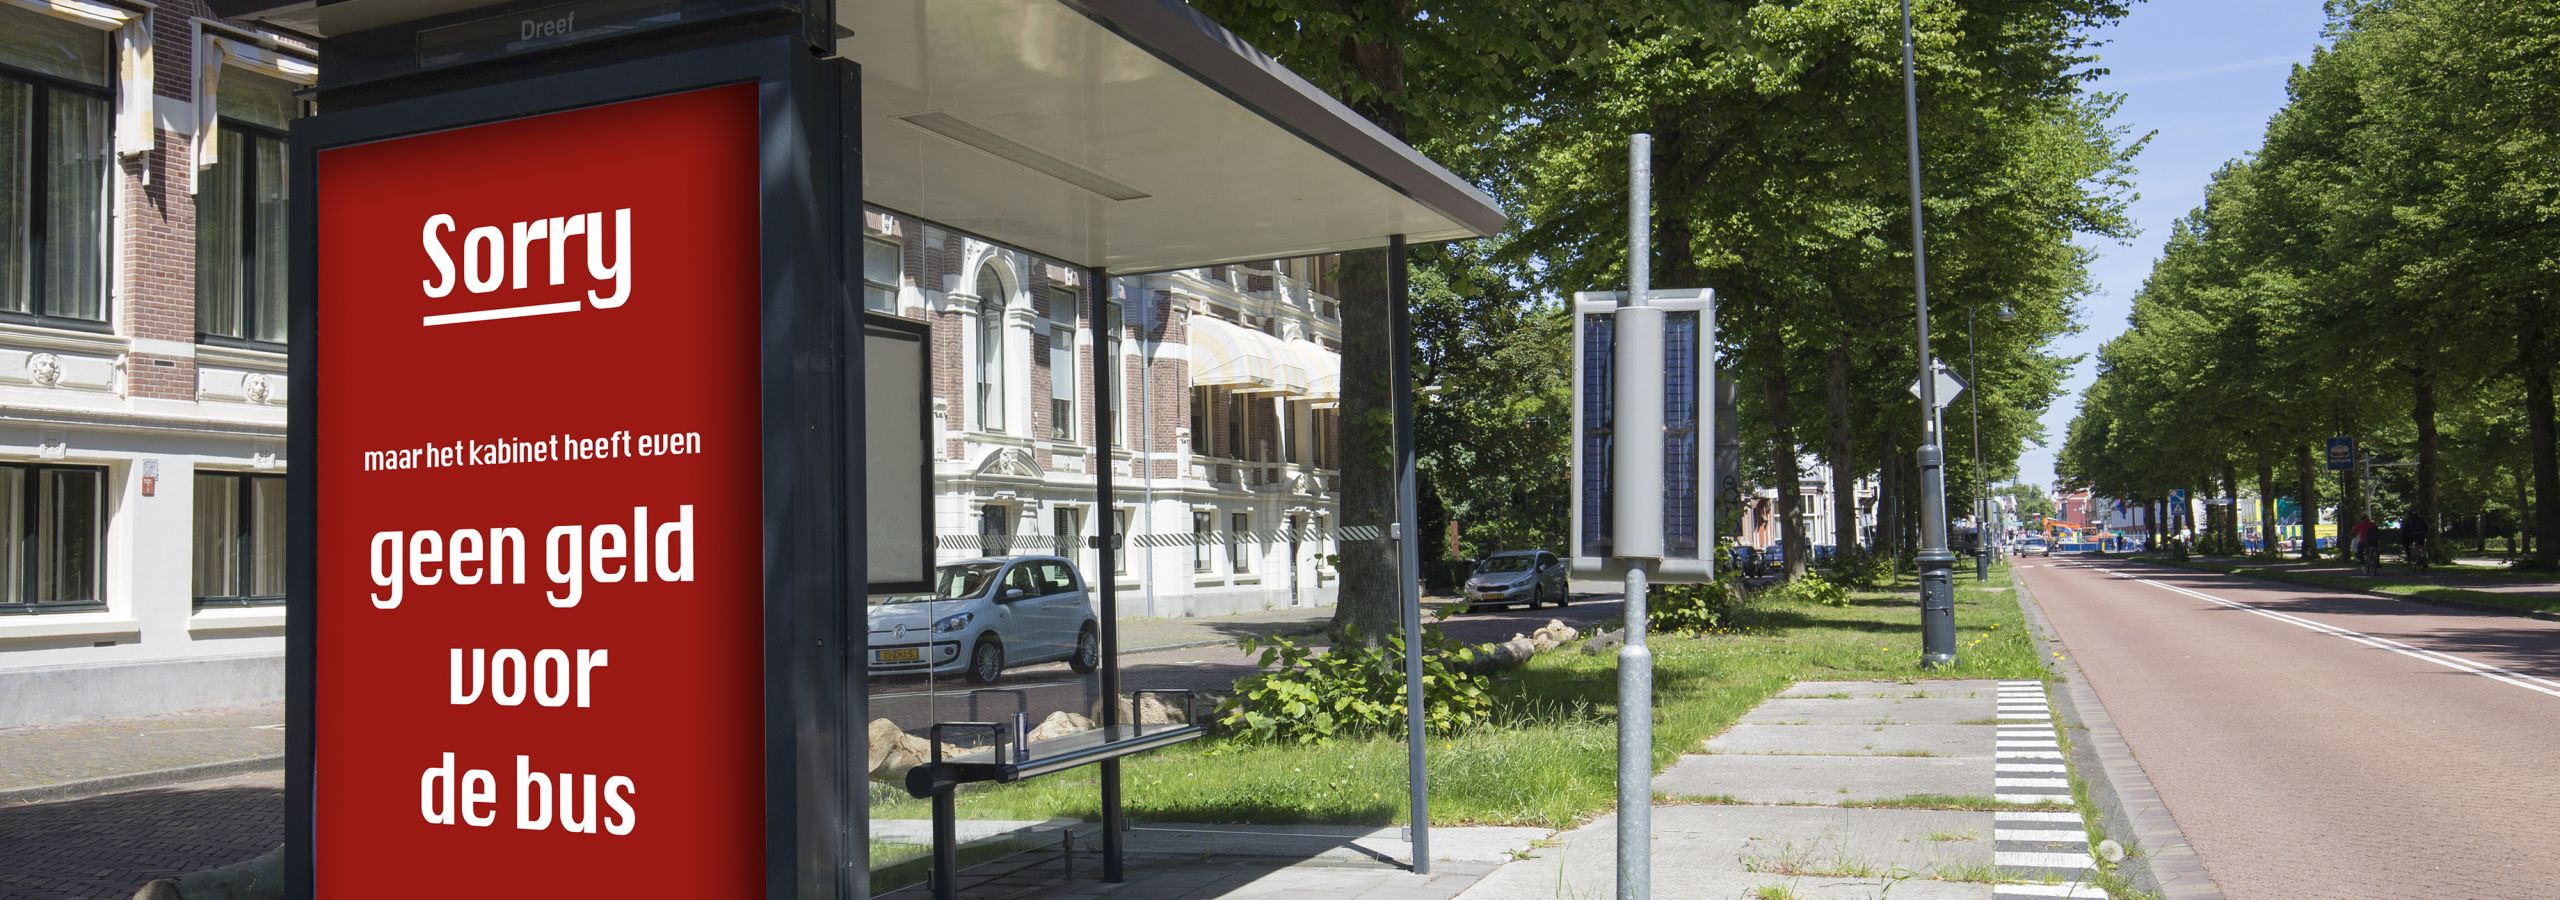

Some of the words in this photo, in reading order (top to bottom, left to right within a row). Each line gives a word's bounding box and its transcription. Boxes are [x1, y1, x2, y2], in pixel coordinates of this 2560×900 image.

[521, 11, 575, 41] Dreef
[422, 207, 632, 310] Sorry
[364, 448, 423, 472] maar
[426, 441, 464, 468] het
[469, 434, 559, 466] kabinet
[564, 430, 632, 461] heeft
[638, 431, 701, 457] even
[370, 526, 526, 610] geen
[545, 504, 694, 608] geld
[450, 648, 608, 708] voor
[420, 751, 497, 827] de
[516, 754, 636, 836] bus
